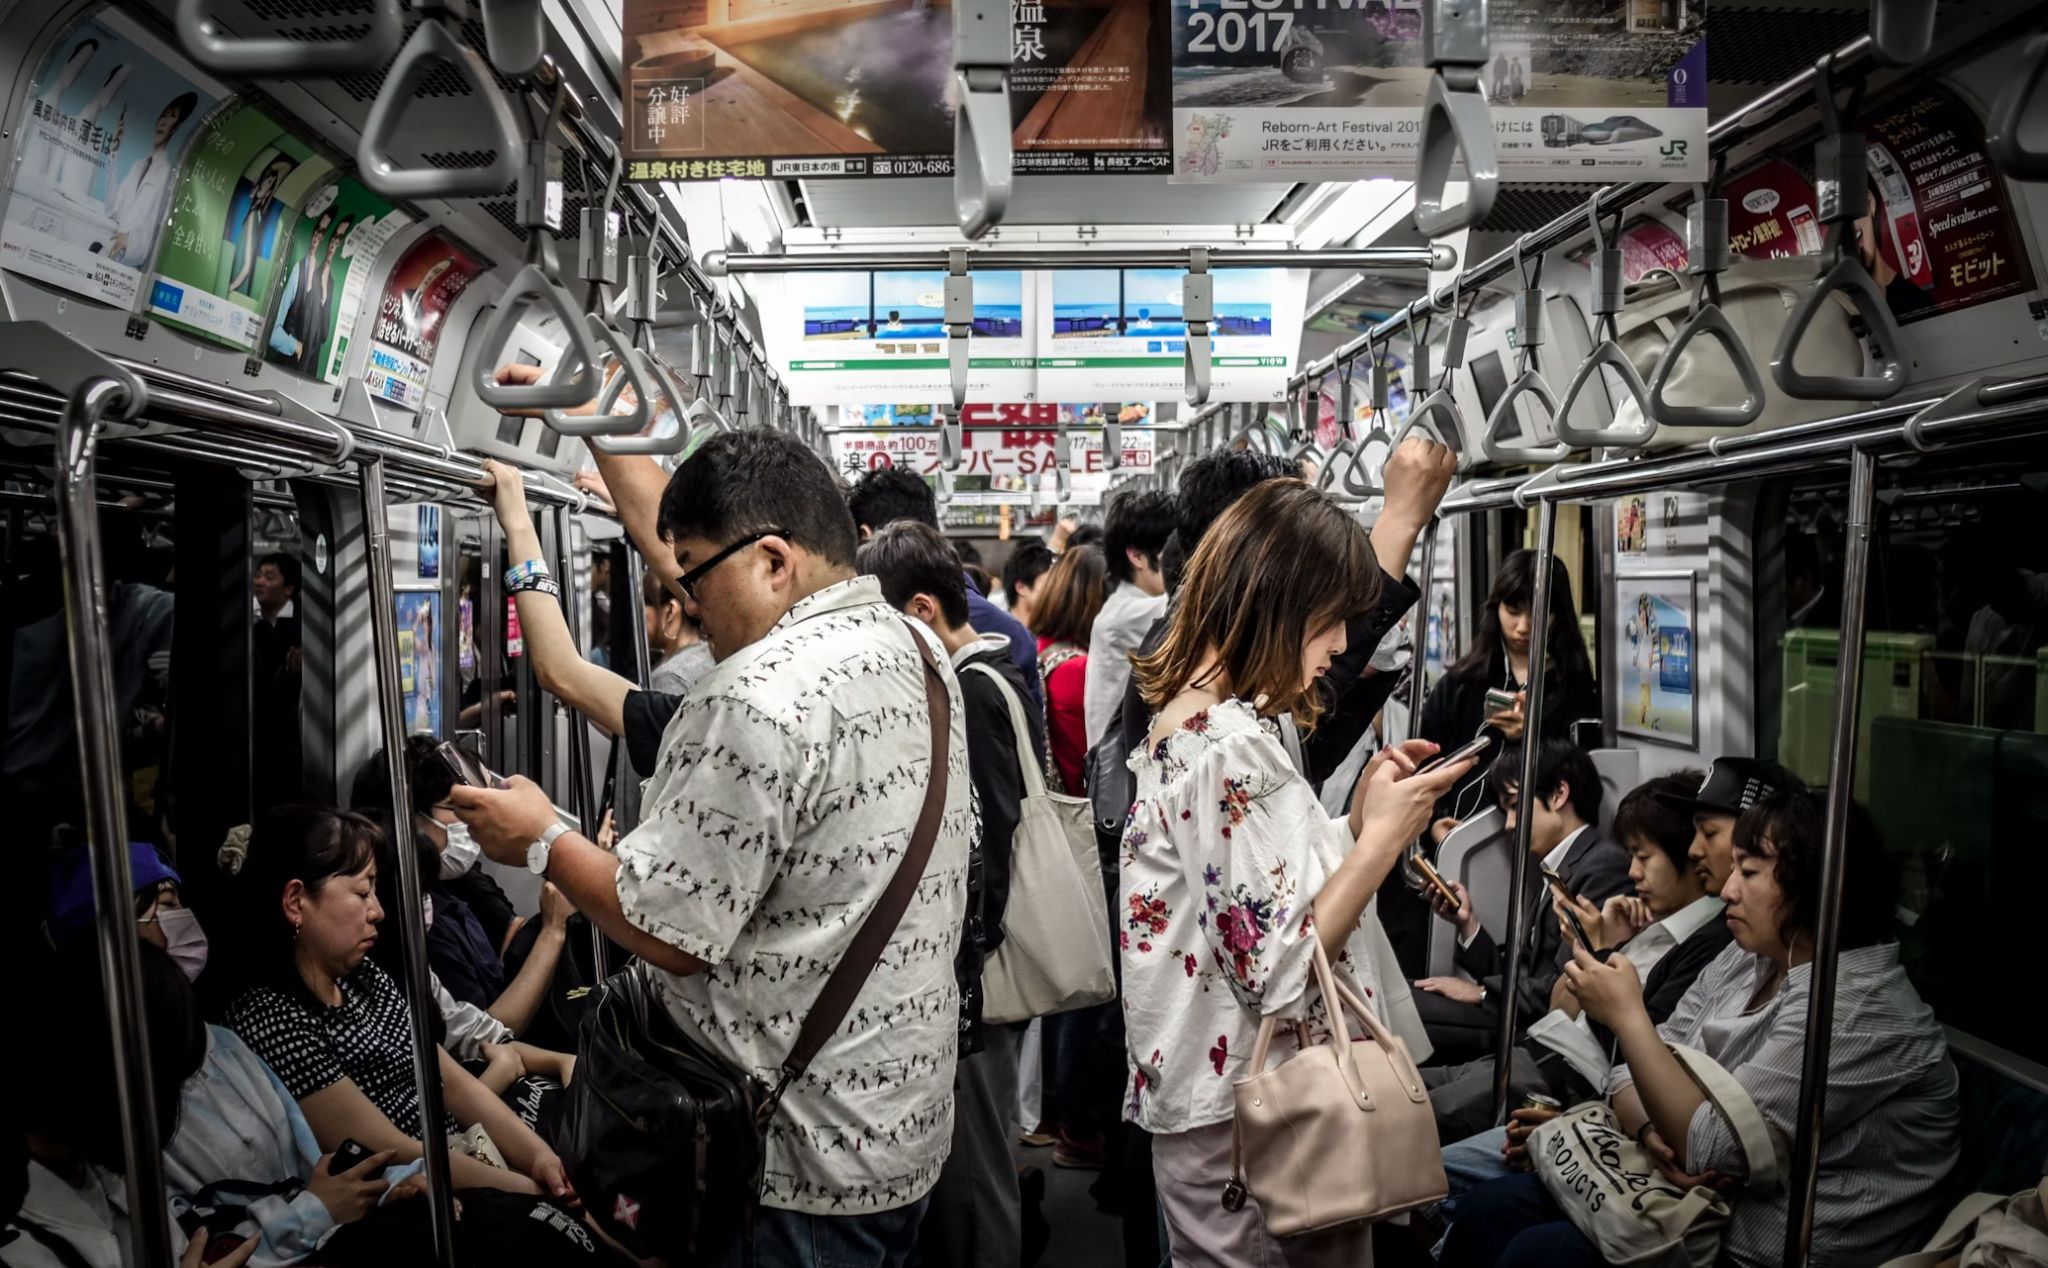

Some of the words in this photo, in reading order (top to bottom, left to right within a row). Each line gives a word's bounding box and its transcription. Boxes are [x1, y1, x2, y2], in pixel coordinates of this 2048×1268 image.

[1187, 12, 1294, 52] 2017
[648, 87, 667, 144] 分譲中
[670, 86, 690, 124] 好評
[1262, 121, 1337, 133] Reborn-Art
[1343, 121, 1393, 133] Festival
[1397, 121, 1422, 133] 201
[1493, 121, 1533, 133] けには
[1262, 138, 1386, 152] JRをご利用ください。
[1660, 140, 1688, 156] JR
[629, 160, 766, 180] 温泉付き住宅地
[776, 161, 841, 172] JR東日本の街
[1135, 157, 1170, 166] アーベスト
[1928, 213, 1950, 239] Speed
[1956, 207, 1979, 226] value.
[1950, 251, 2005, 288] モビット
[1549, 1130, 1607, 1213] PRODUCTS
